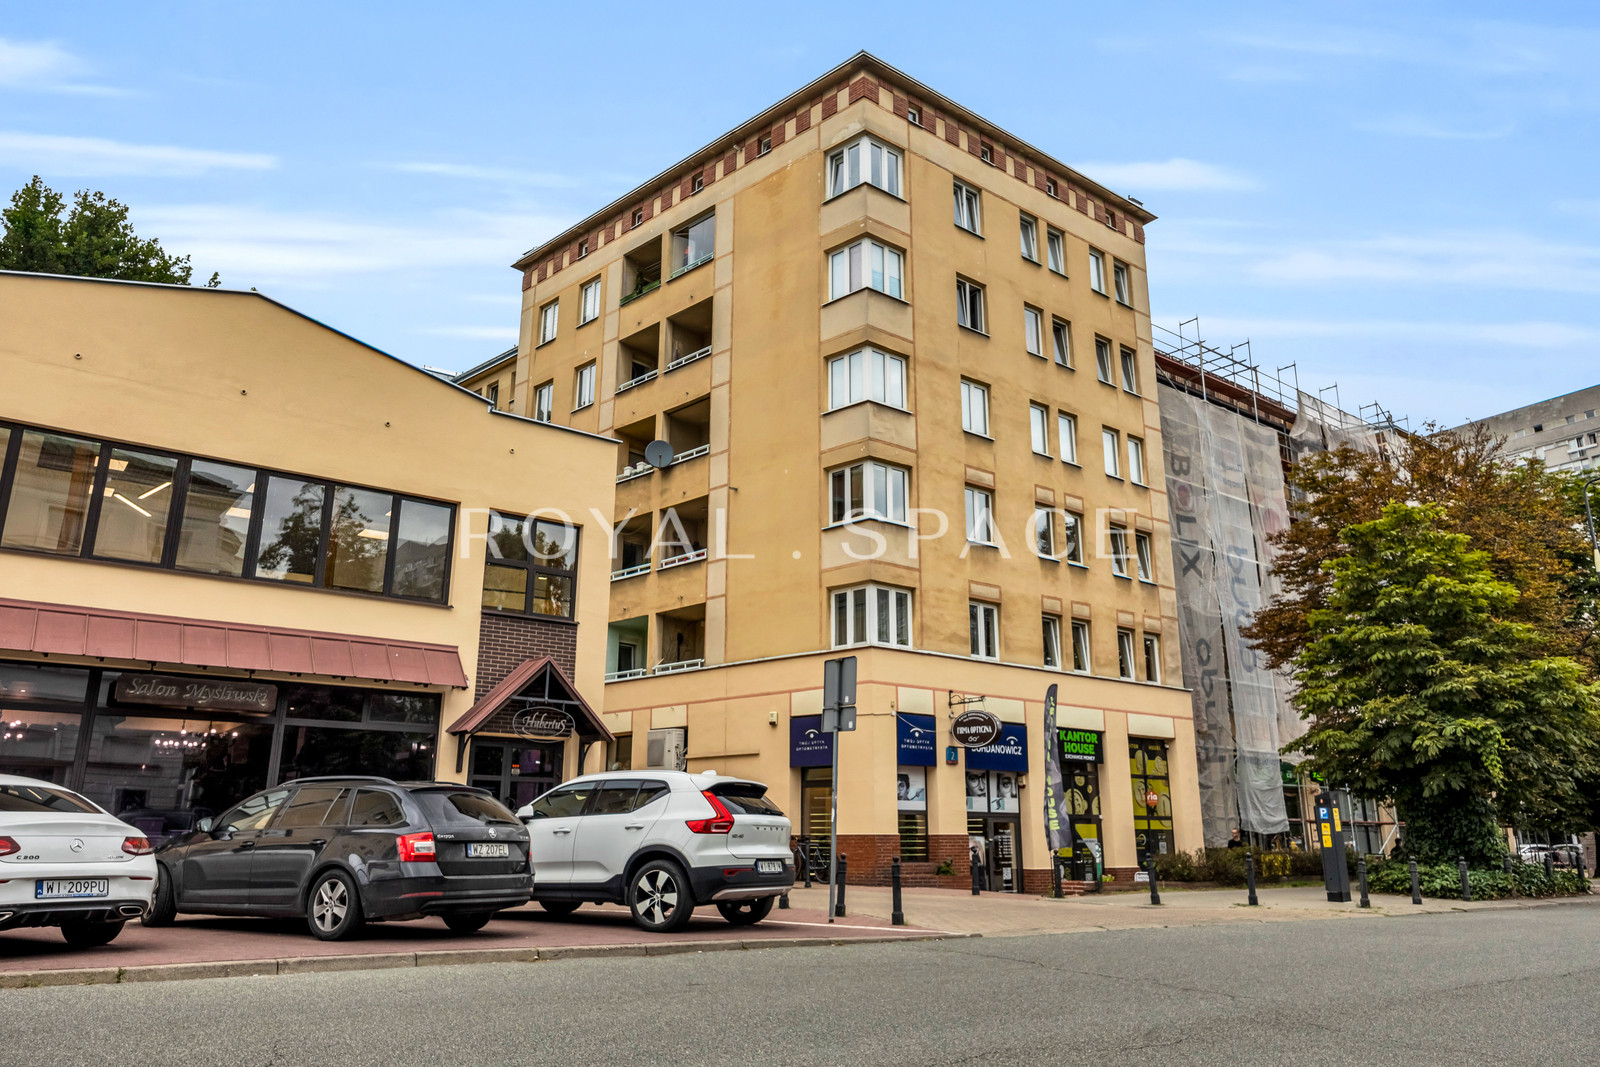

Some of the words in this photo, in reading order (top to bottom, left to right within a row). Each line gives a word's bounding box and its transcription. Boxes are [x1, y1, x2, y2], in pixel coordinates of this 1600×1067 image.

[125, 677, 177, 697] Salon
[182, 683, 269, 707] Myśliwski
[522, 711, 567, 731] Hubertus
[1059, 729, 1099, 744] KANTOR
[1063, 741, 1096, 755] HOUSE
[1146, 791, 1158, 801] ria
[1319, 807, 1327, 816] P
[472, 842, 484, 855] WZ
[486, 843, 508, 855] 207EL
[46, 881, 61, 894] WI
[67, 880, 106, 894] 209PU
